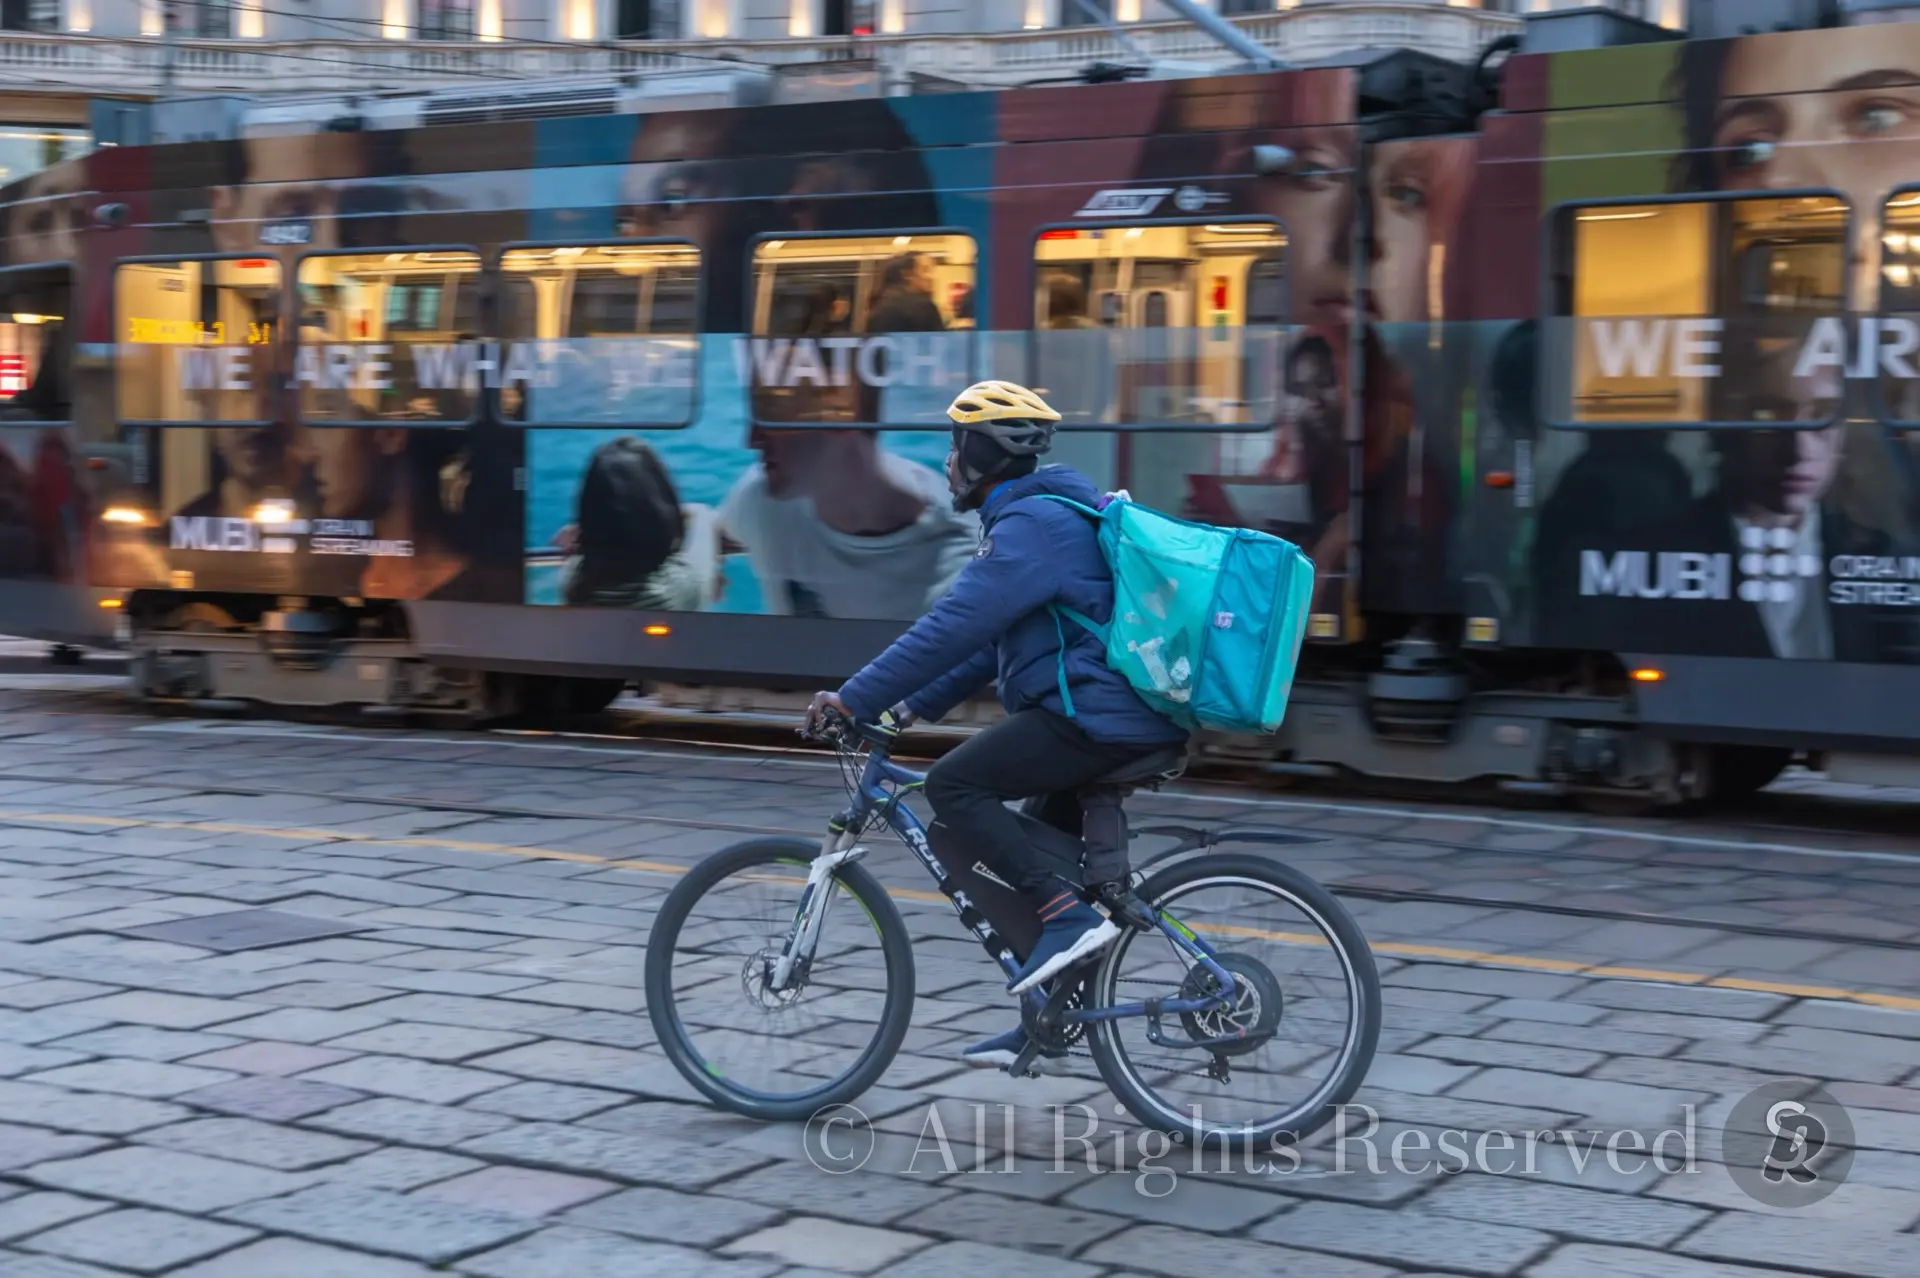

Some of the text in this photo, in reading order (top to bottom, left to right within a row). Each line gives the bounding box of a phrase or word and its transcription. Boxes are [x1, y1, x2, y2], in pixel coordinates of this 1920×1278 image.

[284, 344, 394, 389] ARE
[731, 336, 948, 387] WATCH
[1590, 318, 1723, 378] WE
[1580, 549, 1732, 601] MUBI
